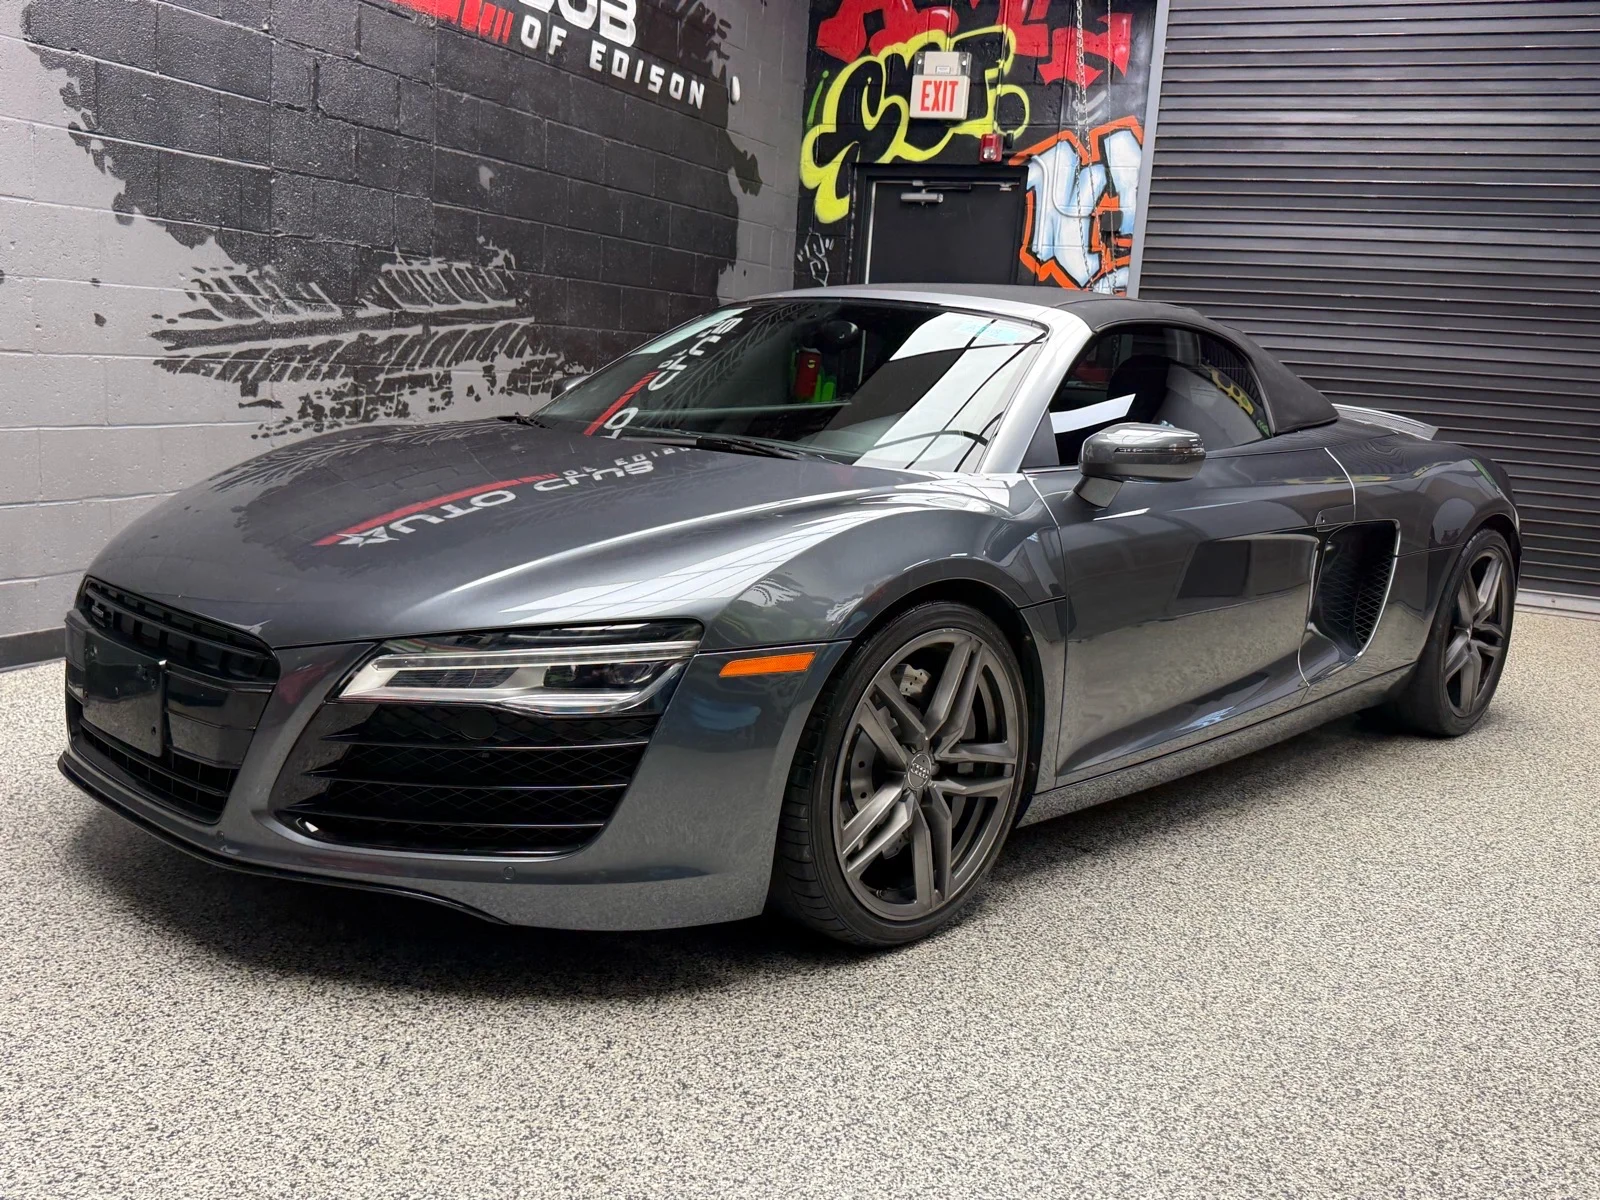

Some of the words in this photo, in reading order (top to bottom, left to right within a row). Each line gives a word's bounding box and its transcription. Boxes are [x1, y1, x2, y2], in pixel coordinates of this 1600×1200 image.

[520, 14, 568, 56] OF
[589, 40, 705, 109] EDISON
[920, 80, 959, 112] EXIT
